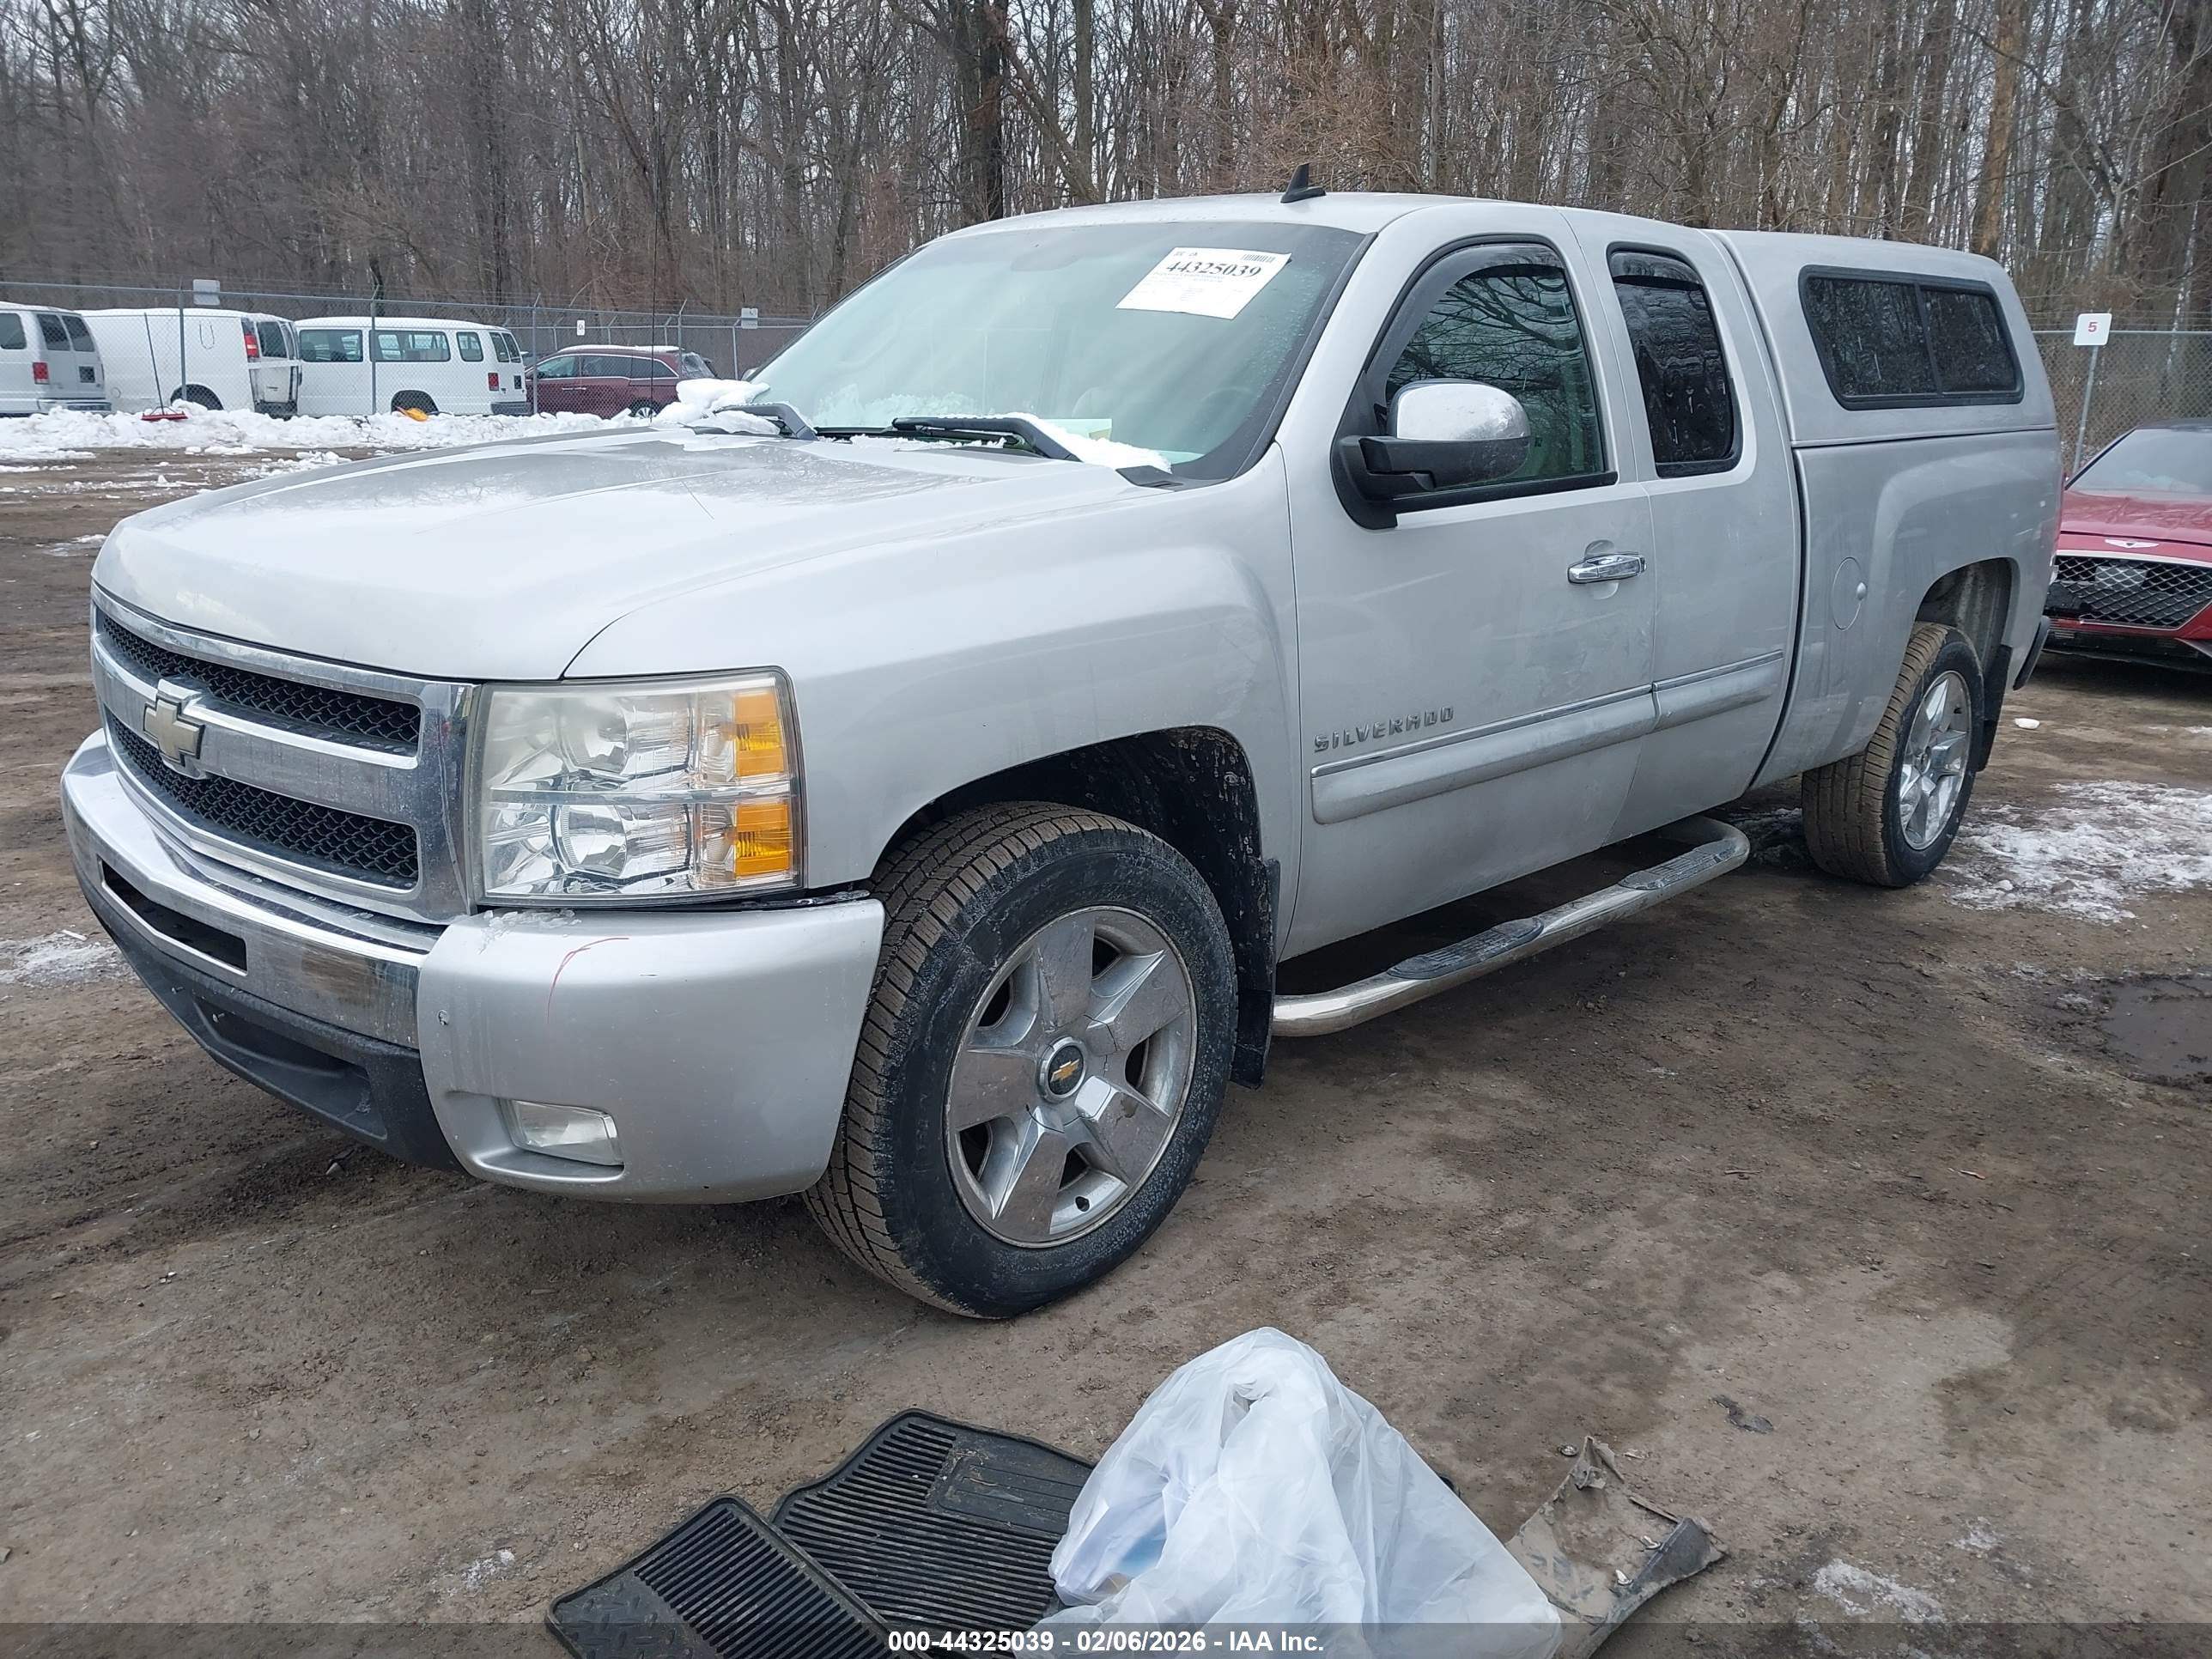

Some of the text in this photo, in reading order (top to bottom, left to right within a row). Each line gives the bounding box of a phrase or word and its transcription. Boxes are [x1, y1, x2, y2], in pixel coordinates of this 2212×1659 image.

[1166, 261, 1262, 277] 44325039
[2088, 321, 2098, 333] 5
[1314, 706, 1454, 753] SILVERADO
